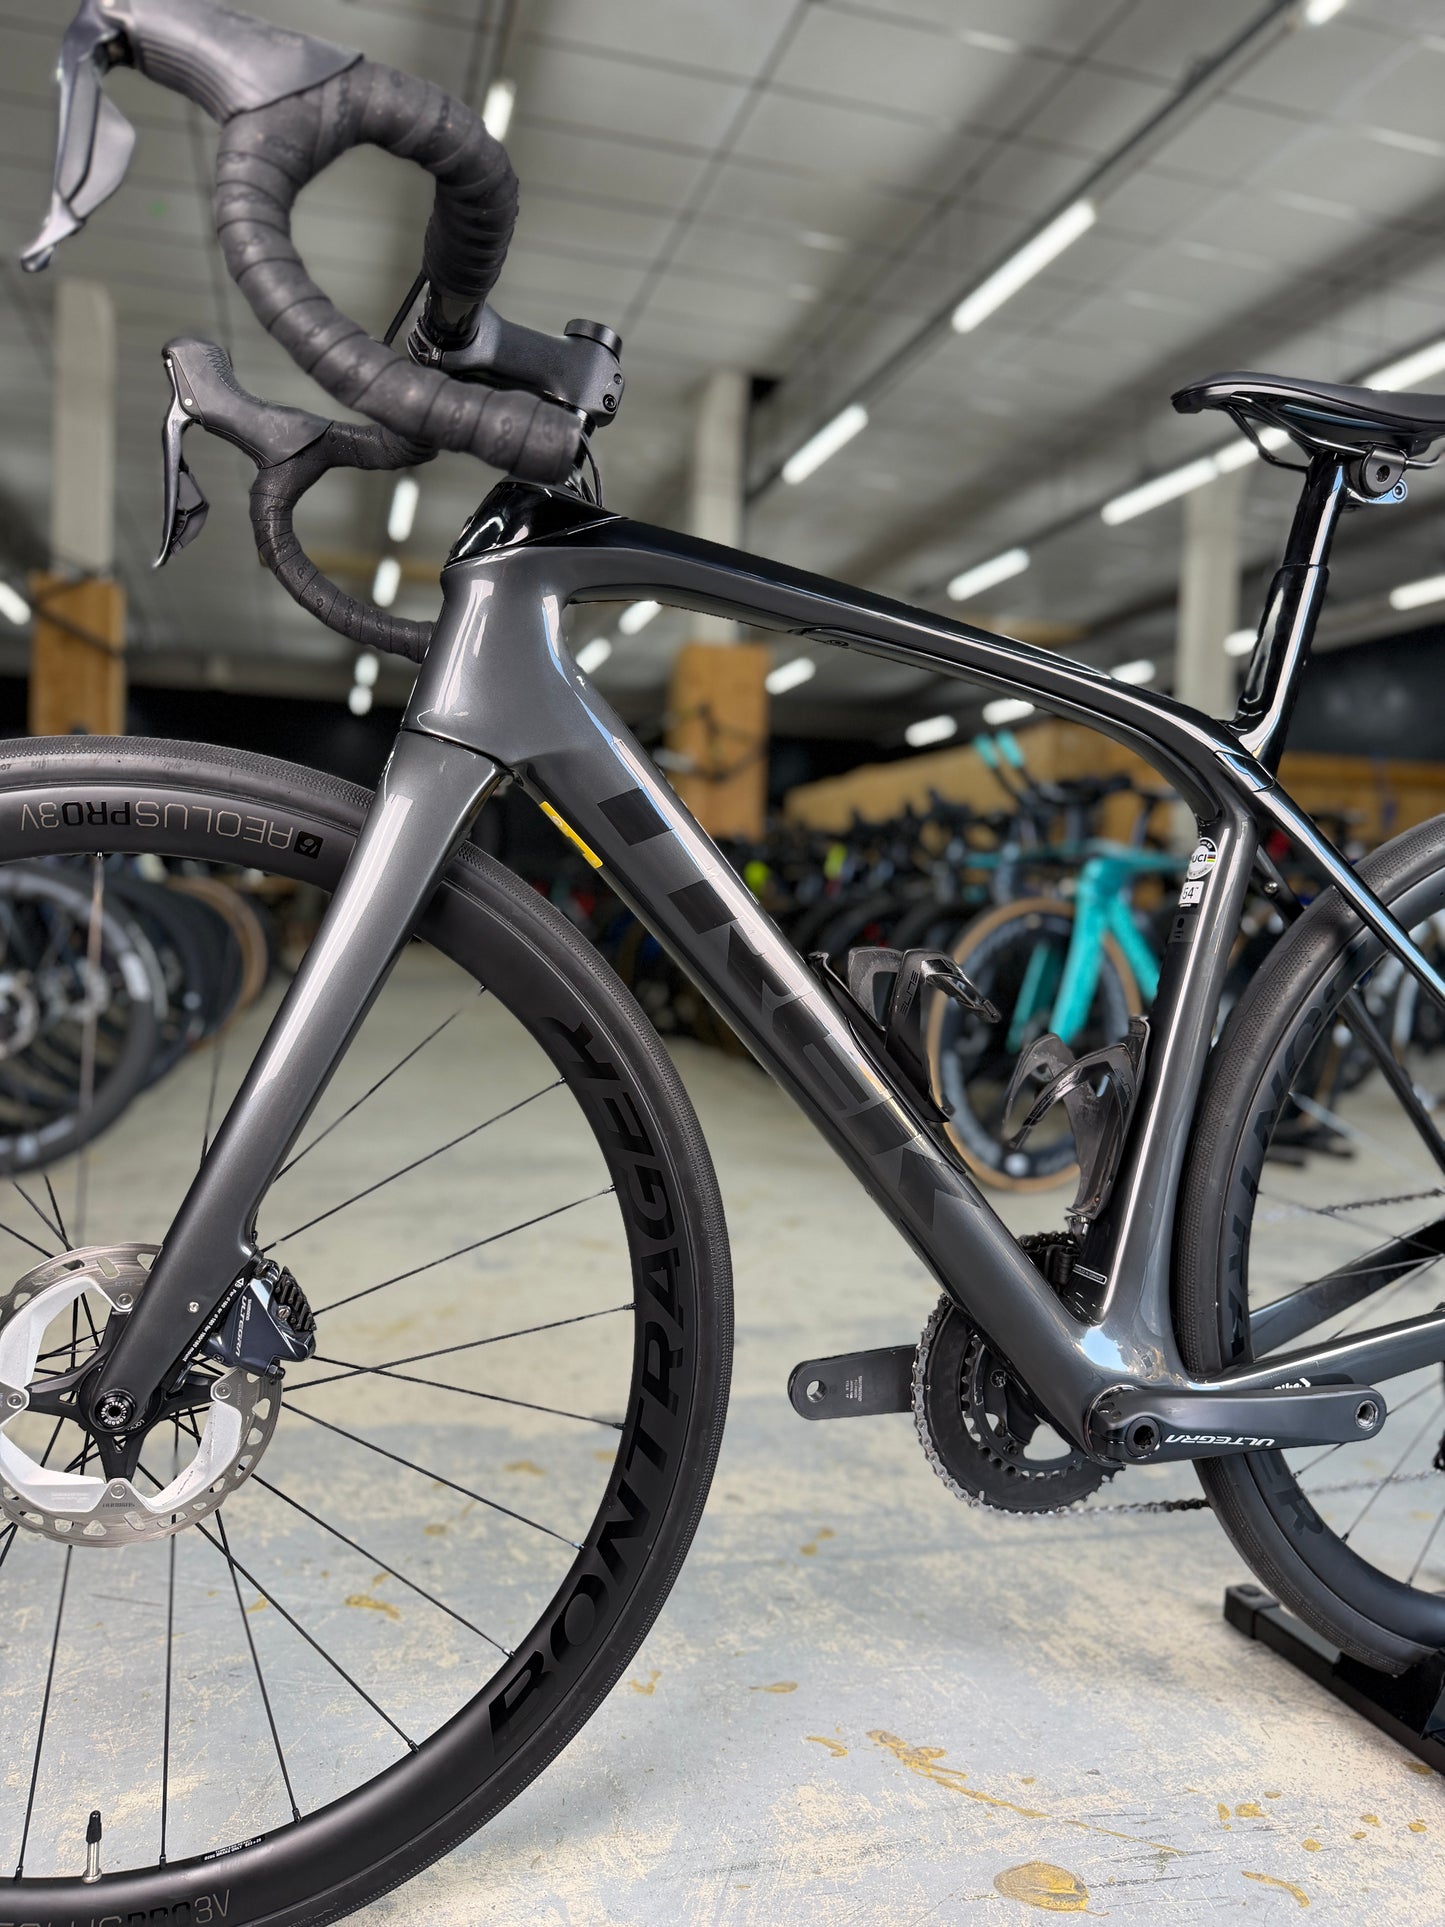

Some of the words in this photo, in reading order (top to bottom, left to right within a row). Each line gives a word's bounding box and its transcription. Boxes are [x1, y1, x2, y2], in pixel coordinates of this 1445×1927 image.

[1191, 853, 1207, 864] UCI
[597, 775, 983, 1231] TREK
[900, 970, 919, 1017] ELITE
[235, 1295, 247, 1357] ULTEGRA
[488, 1017, 685, 1757] BONTRAGER
[1164, 1434, 1275, 1448] ULTEGRA
